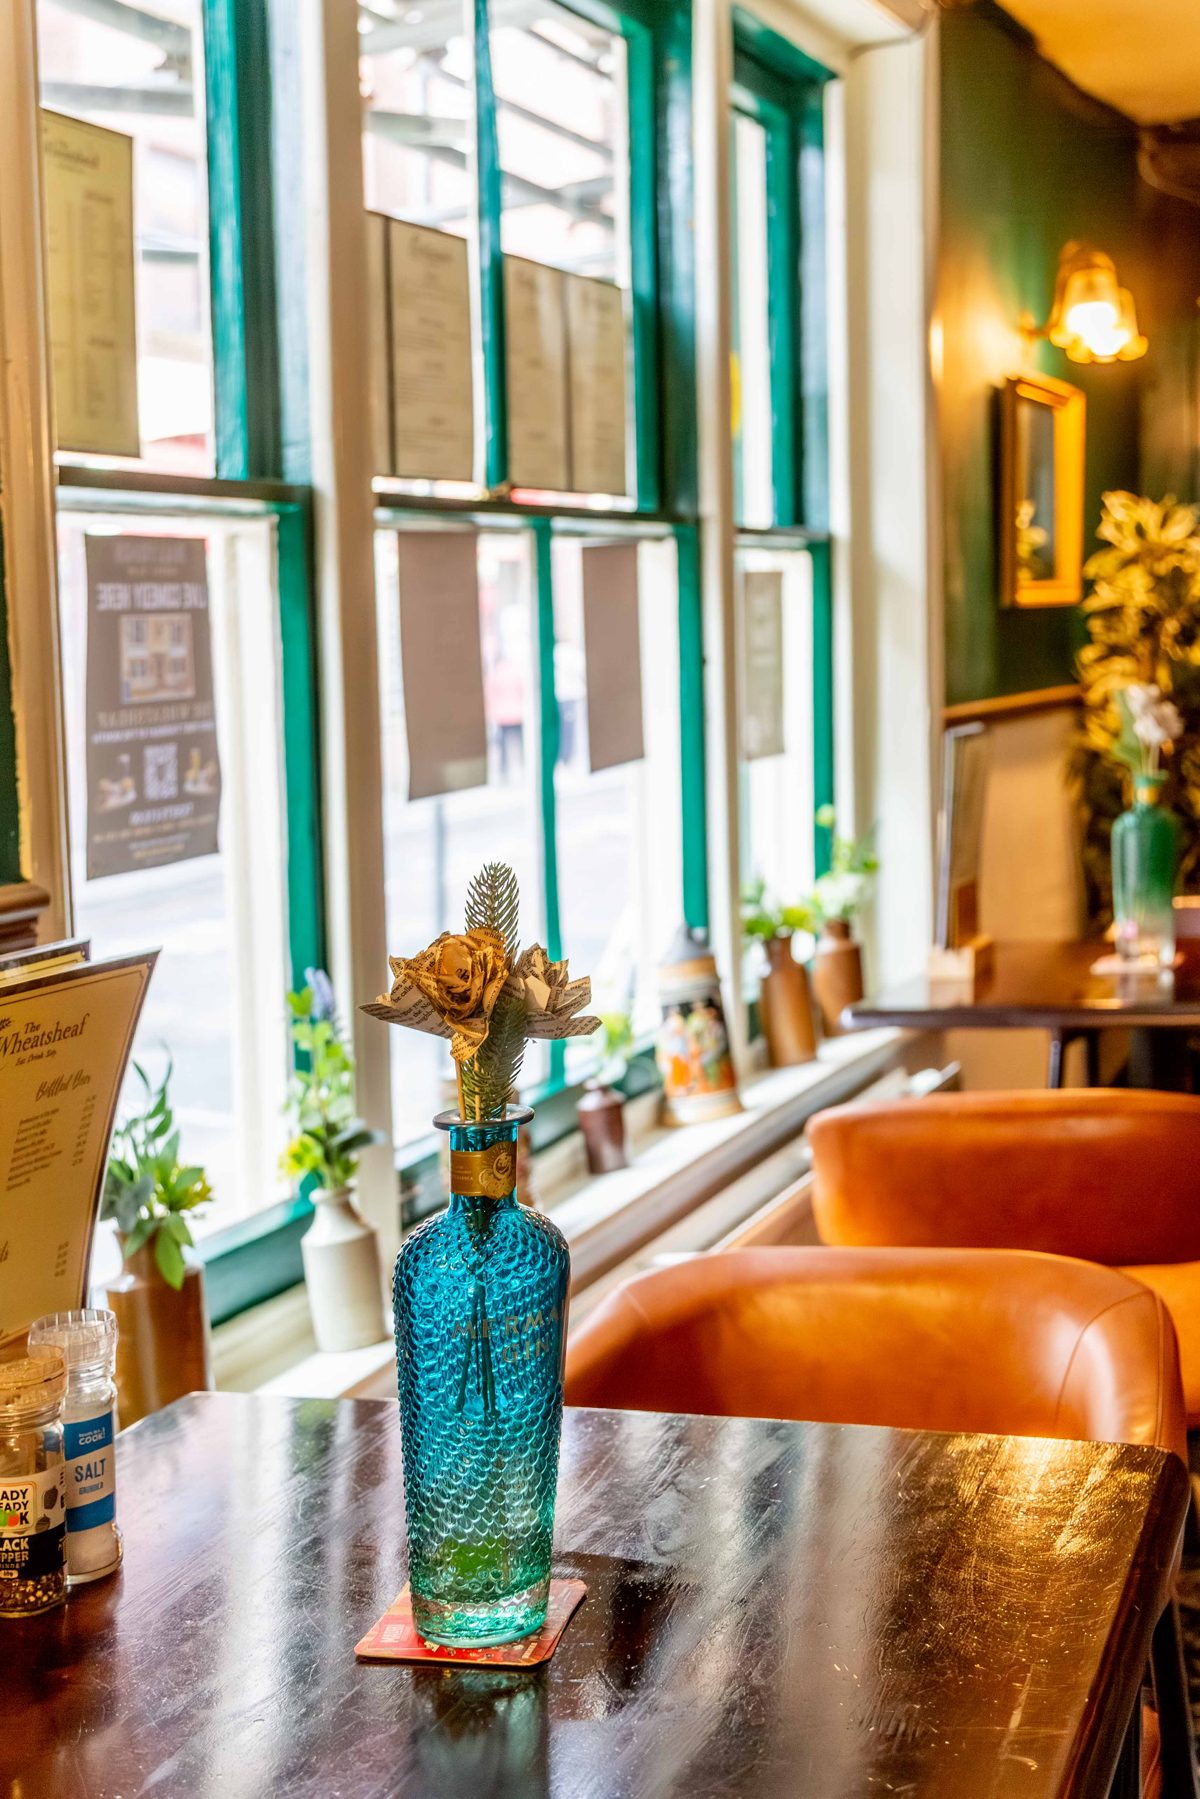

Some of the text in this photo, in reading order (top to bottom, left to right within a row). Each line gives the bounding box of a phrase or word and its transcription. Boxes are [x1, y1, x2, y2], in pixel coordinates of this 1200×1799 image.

[0, 1013, 90, 1057] Wheatsheaf
[25, 1022, 41, 1035] The
[502, 1338, 549, 1363] GIN
[75, 1457, 106, 1482] SALT
[0, 1537, 29, 1551] ACK
[0, 1551, 29, 1562] PPER
